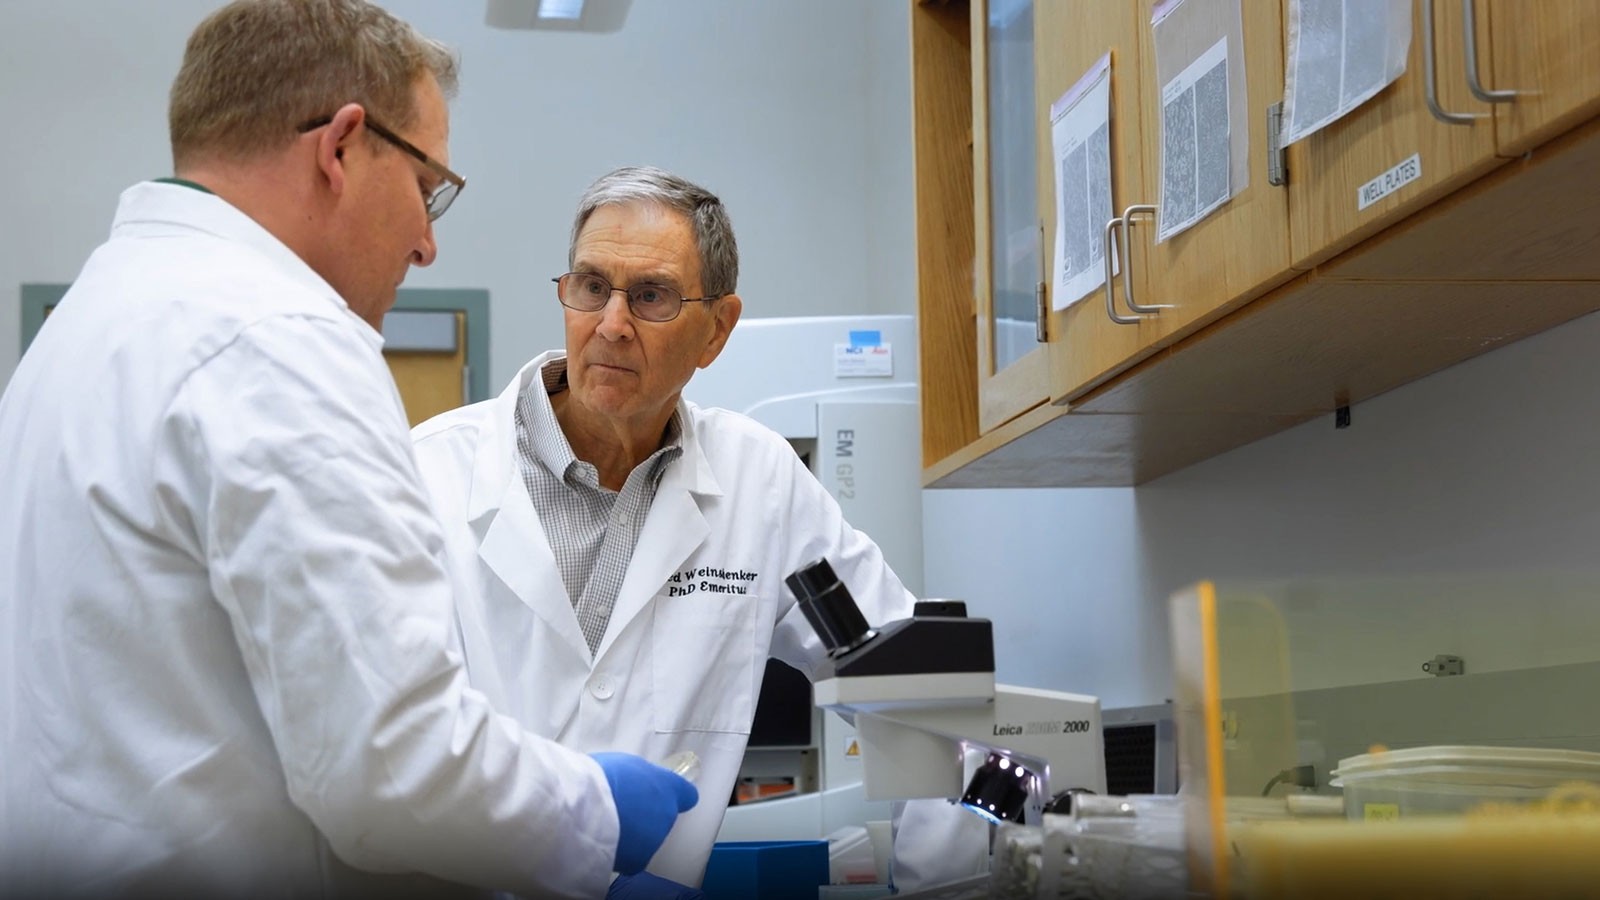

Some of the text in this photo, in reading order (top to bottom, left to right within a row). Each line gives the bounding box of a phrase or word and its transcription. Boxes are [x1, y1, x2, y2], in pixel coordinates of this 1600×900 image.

[1362, 159, 1416, 204] WELL PLATES
[836, 429, 856, 500] EM GP2
[669, 583, 696, 597] PhD
[993, 724, 1022, 736] Leica
[1063, 720, 1089, 733] 2000
